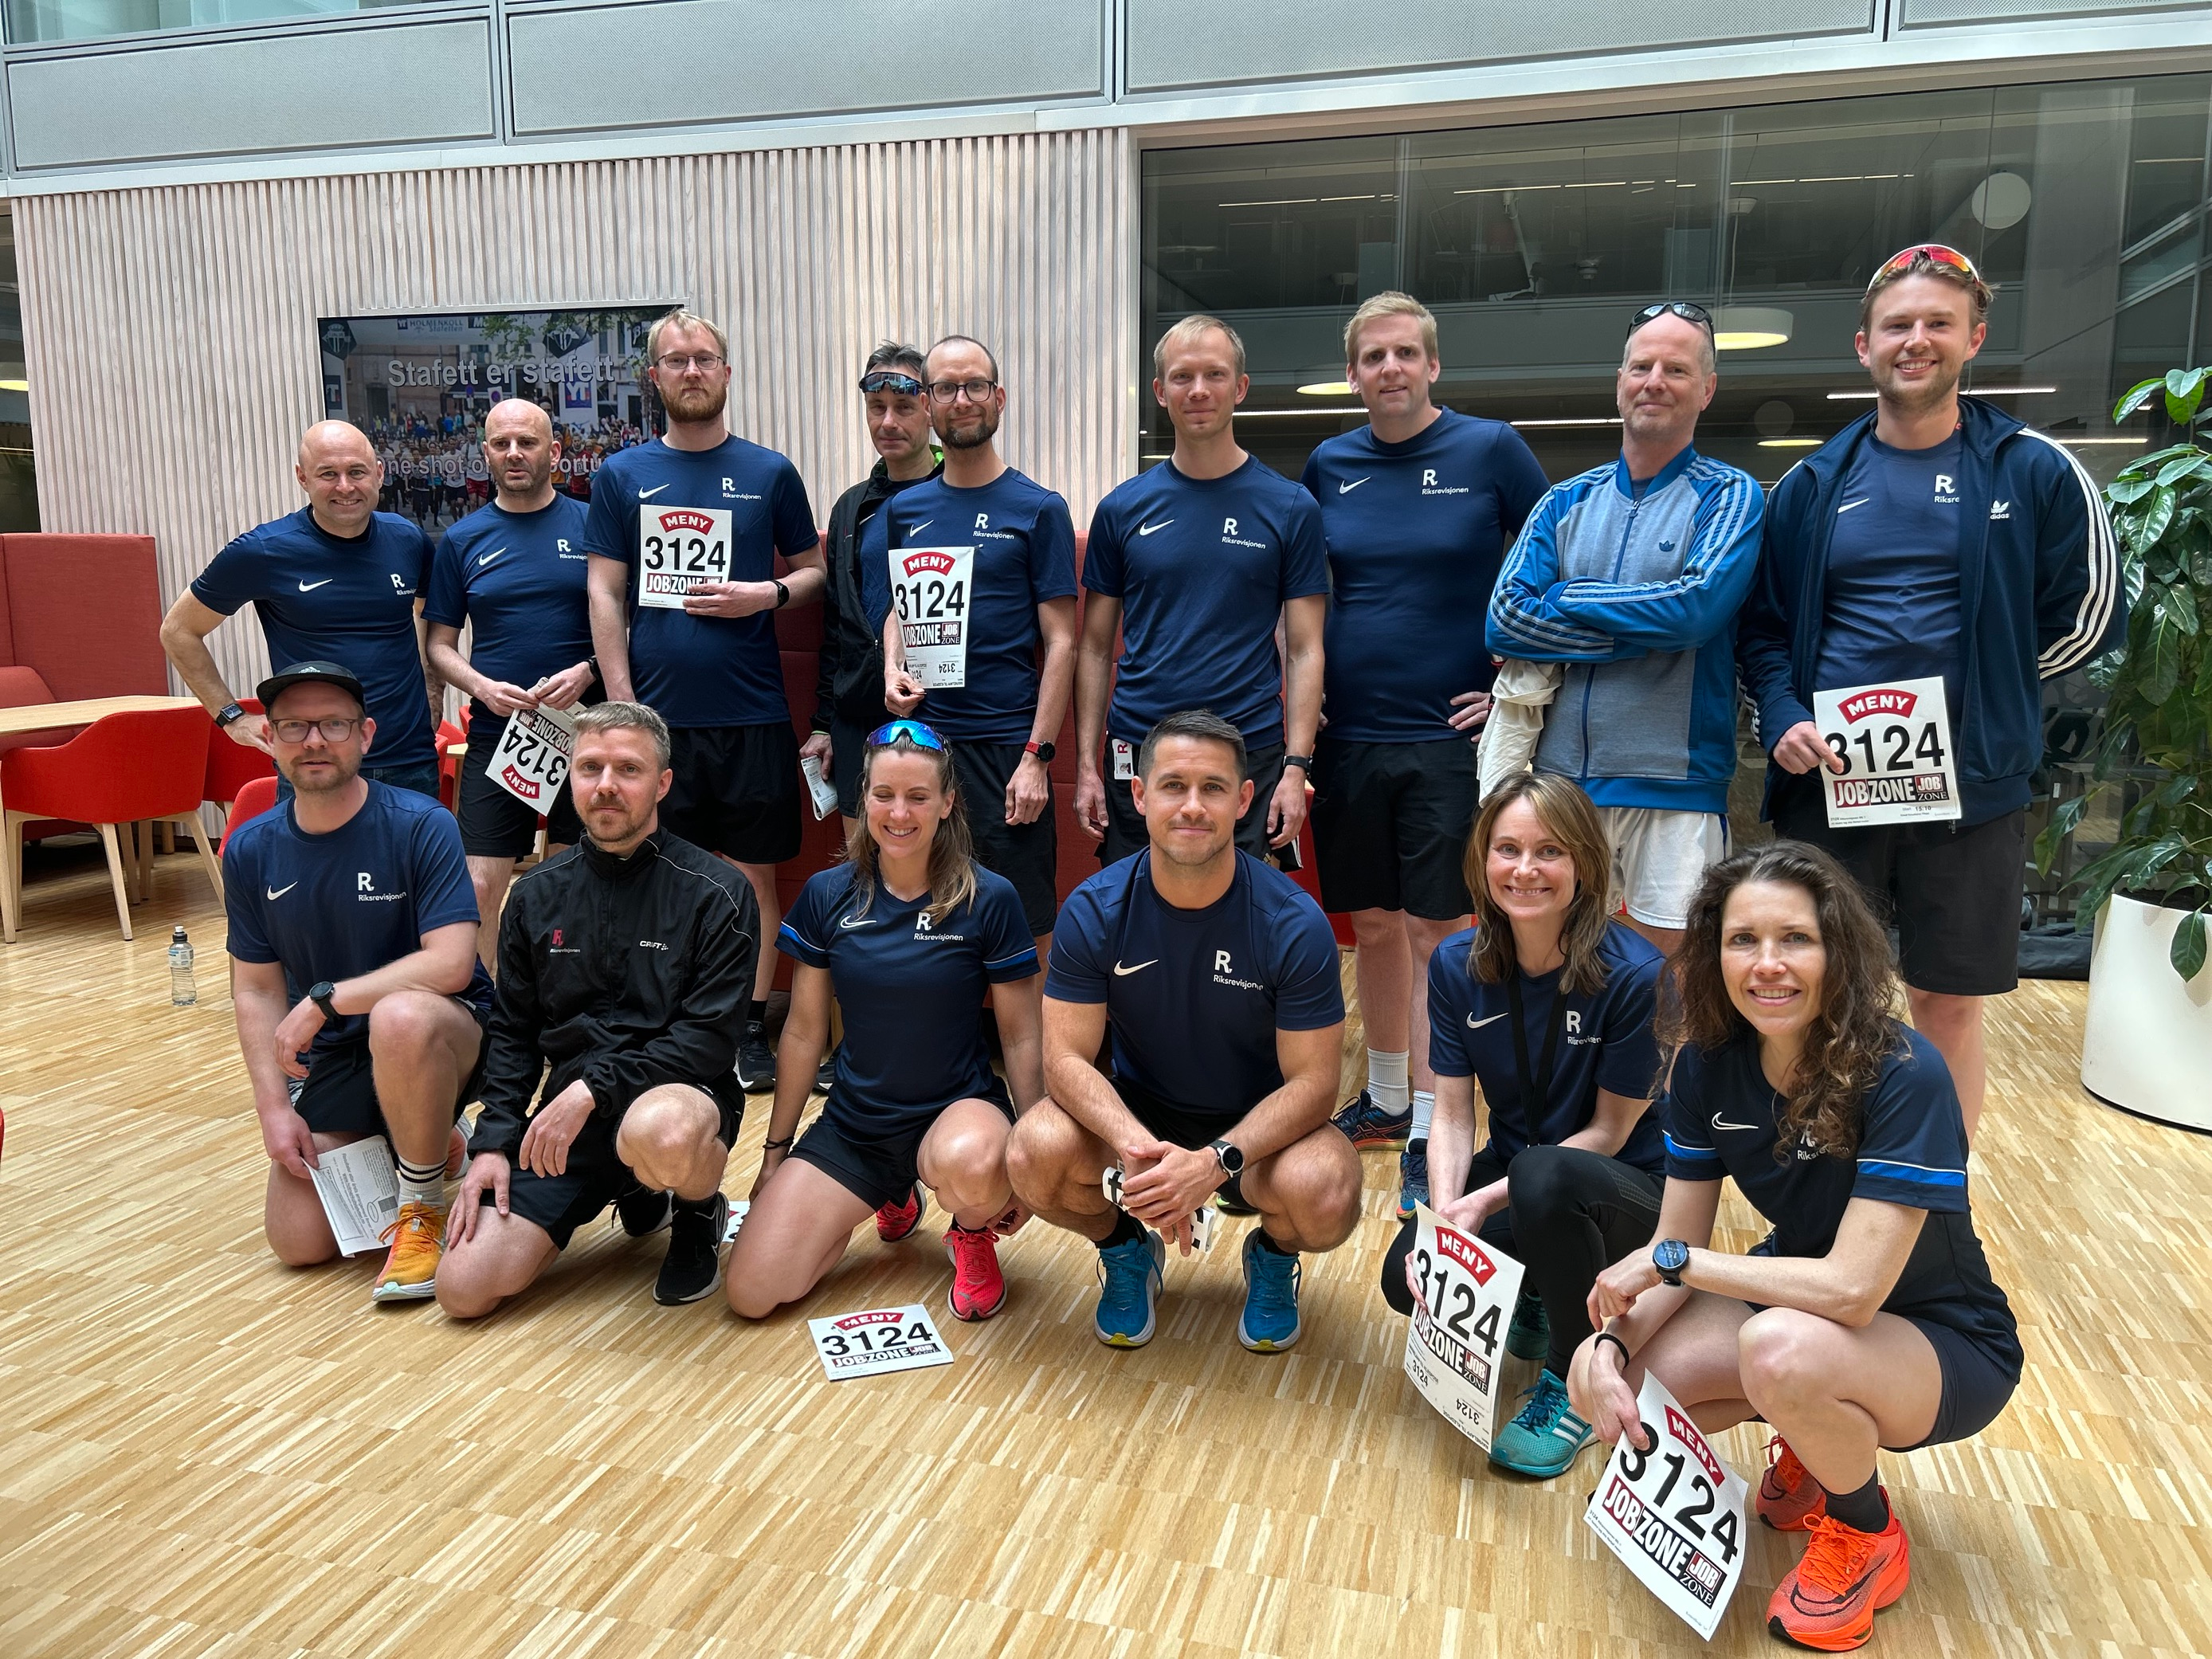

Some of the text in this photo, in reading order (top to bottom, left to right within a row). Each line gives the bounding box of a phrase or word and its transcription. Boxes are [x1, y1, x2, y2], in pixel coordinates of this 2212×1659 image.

[388, 355, 615, 387] Stafett er stafett
[566, 382, 591, 401] YT
[418, 454, 465, 475] shot
[722, 477, 736, 492] R
[1422, 469, 1438, 486] R
[1935, 474, 1955, 494] R
[665, 515, 708, 530] MENY
[975, 513, 989, 529] R
[1223, 517, 1239, 535] R
[556, 539, 571, 552] R
[973, 530, 1014, 540] Riksrevisjonen
[1222, 535, 1266, 550] Riksrevisjonen
[645, 535, 726, 573] 3124
[908, 555, 951, 571] MENY
[390, 573, 406, 588] R
[895, 579, 965, 622] 3124
[943, 623, 959, 636] JOB
[939, 663, 955, 674] 3124
[1846, 694, 1909, 717] MENY
[503, 724, 567, 786] 3124
[1824, 722, 1945, 777] 3124
[505, 771, 536, 796] MENY
[1917, 776, 1942, 791] JOB
[1917, 791, 1948, 802] ZONE
[357, 872, 375, 891] R
[916, 912, 932, 931] R
[913, 932, 963, 941] Riksrevisjonen
[1214, 950, 1233, 974] R
[1567, 1010, 1581, 1034] R
[1441, 1232, 1490, 1275] MENY
[1416, 1248, 1502, 1358] 3124
[843, 1314, 898, 1328] MENY
[822, 1322, 933, 1356] 3124
[1411, 1359, 1429, 1387] 3124
[1465, 1352, 1487, 1382] JOB
[1463, 1369, 1488, 1394] ZONE
[1456, 1398, 1480, 1426] 3124
[1670, 1414, 1719, 1474] MENY
[1619, 1421, 1739, 1566] 3124
[1689, 1553, 1720, 1589] JOB
[1680, 1571, 1714, 1607] ZONE
